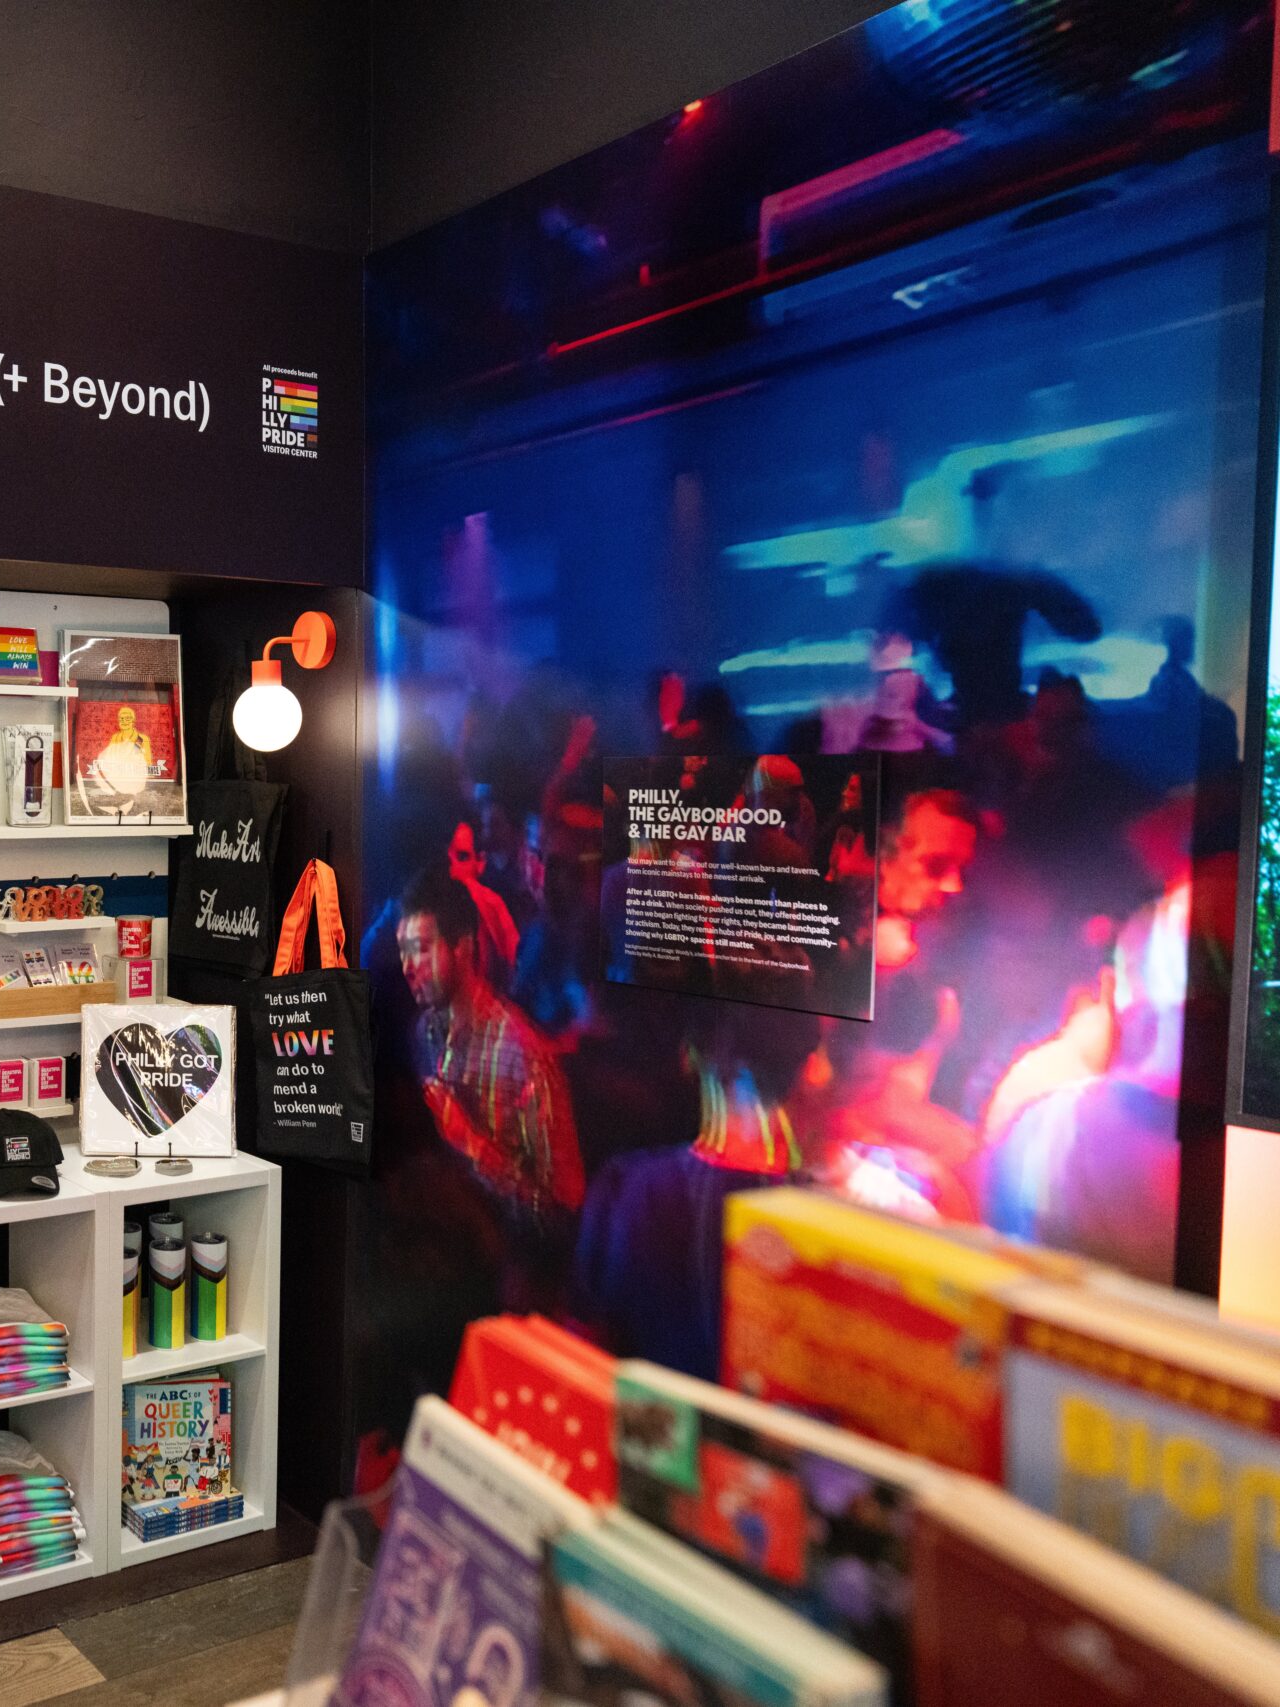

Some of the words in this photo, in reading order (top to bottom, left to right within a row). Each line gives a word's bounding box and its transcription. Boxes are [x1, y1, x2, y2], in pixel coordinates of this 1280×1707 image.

[262, 364, 270, 372] All
[271, 366, 297, 376] proceeds
[298, 370, 318, 379] benefit
[262, 378, 272, 392] P
[44, 361, 211, 433] Beyond)
[262, 394, 278, 410] HI
[262, 410, 287, 428] LLY
[262, 428, 305, 447] PRIDE
[262, 444, 290, 455] VISITOR
[291, 448, 318, 459] CENTER
[9, 636, 28, 644] LOVE
[629, 789, 682, 806] PHILLY,
[628, 806, 654, 821] THE
[658, 806, 786, 828] GAYBORHOOD,
[196, 820, 233, 860] Make
[232, 818, 261, 863] Art
[628, 823, 640, 838] &
[644, 824, 670, 839] THE
[674, 826, 708, 840] GAY
[712, 826, 746, 842] BAR
[196, 888, 260, 938] Accessible
[265, 993, 283, 1006] "let
[285, 994, 300, 1005] us
[301, 990, 327, 1004] then
[269, 1013, 284, 1027] try
[286, 1011, 311, 1023] what
[272, 1029, 334, 1057] LOVE
[116, 1052, 175, 1068] PHILLY
[180, 1054, 218, 1068] GOT
[277, 1066, 289, 1076] can
[292, 1063, 309, 1076] do
[311, 1063, 325, 1075] to
[140, 1072, 193, 1087] PRIDE
[273, 1082, 307, 1095] mend
[310, 1084, 317, 1094] a
[274, 1100, 316, 1114] broken
[277, 1119, 301, 1127] William
[302, 1120, 317, 1128] Penn
[160, 1390, 191, 1401] ABCs
[144, 1401, 204, 1420] QUEER
[140, 1419, 209, 1439] HISTORY
